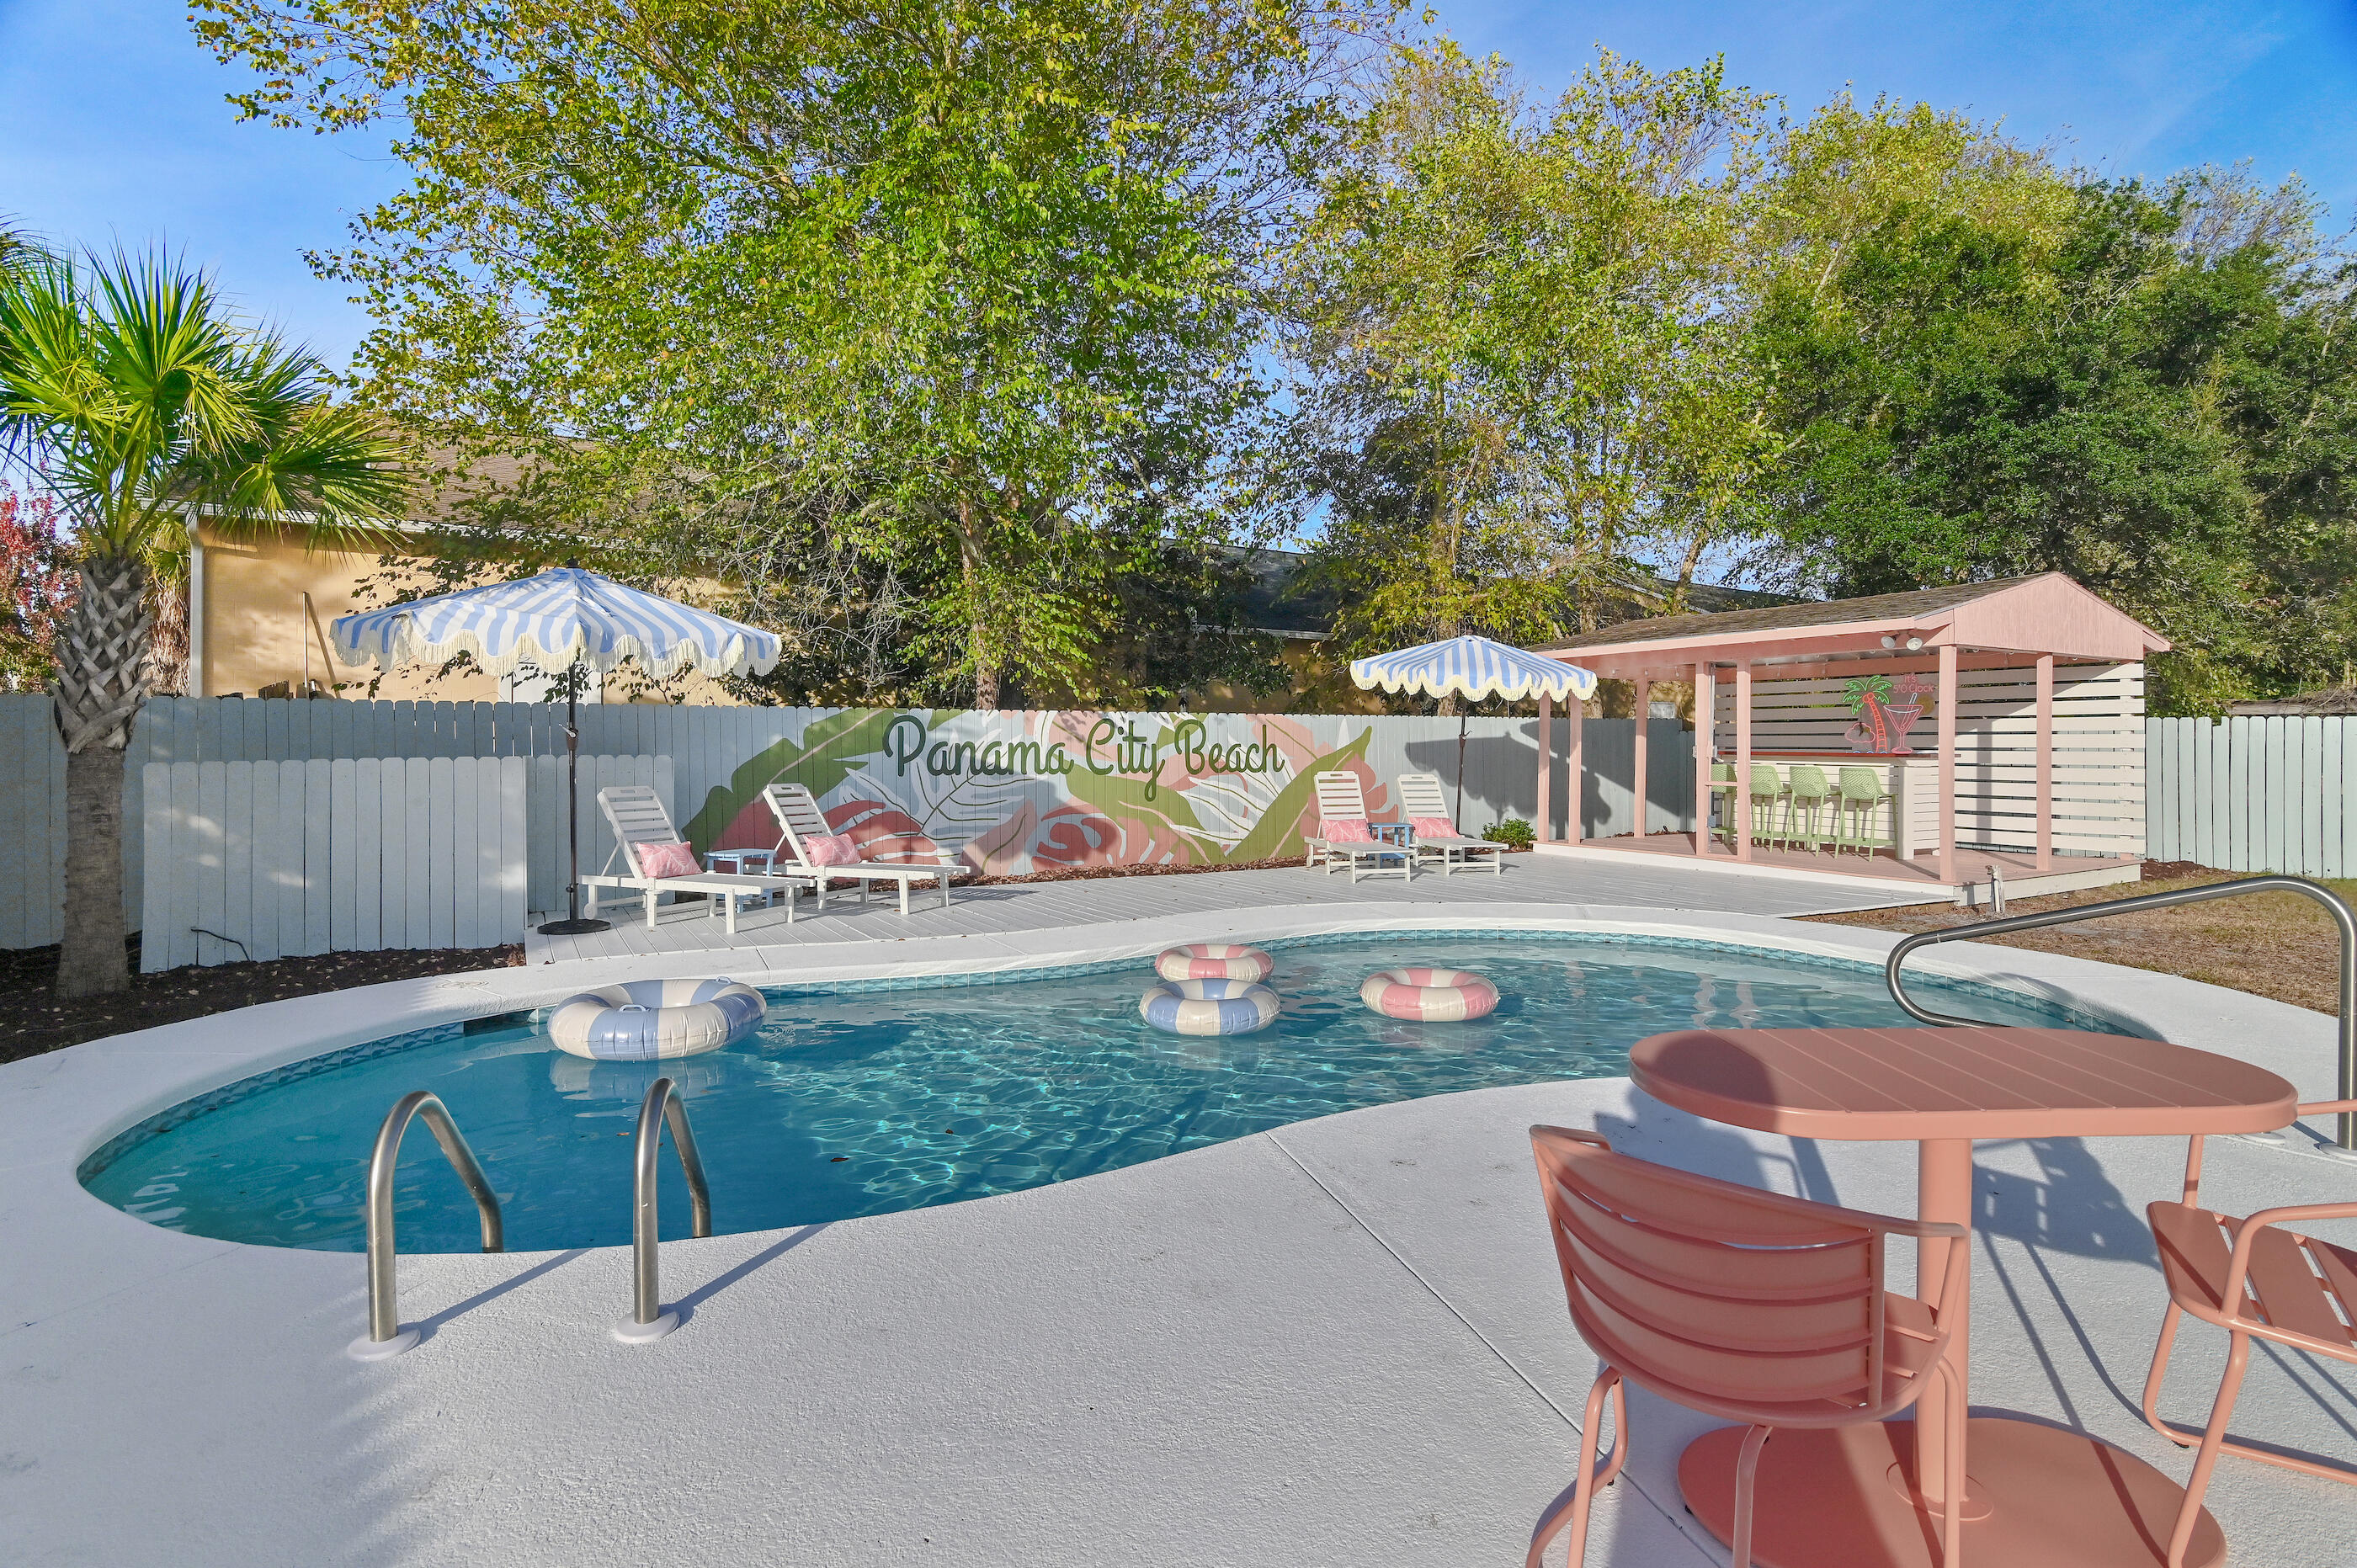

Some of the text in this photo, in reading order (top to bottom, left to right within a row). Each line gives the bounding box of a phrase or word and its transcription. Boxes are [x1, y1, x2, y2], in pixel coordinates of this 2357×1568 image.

[1908, 683, 1934, 693] Clock
[882, 715, 1285, 802] Panama City Beach
